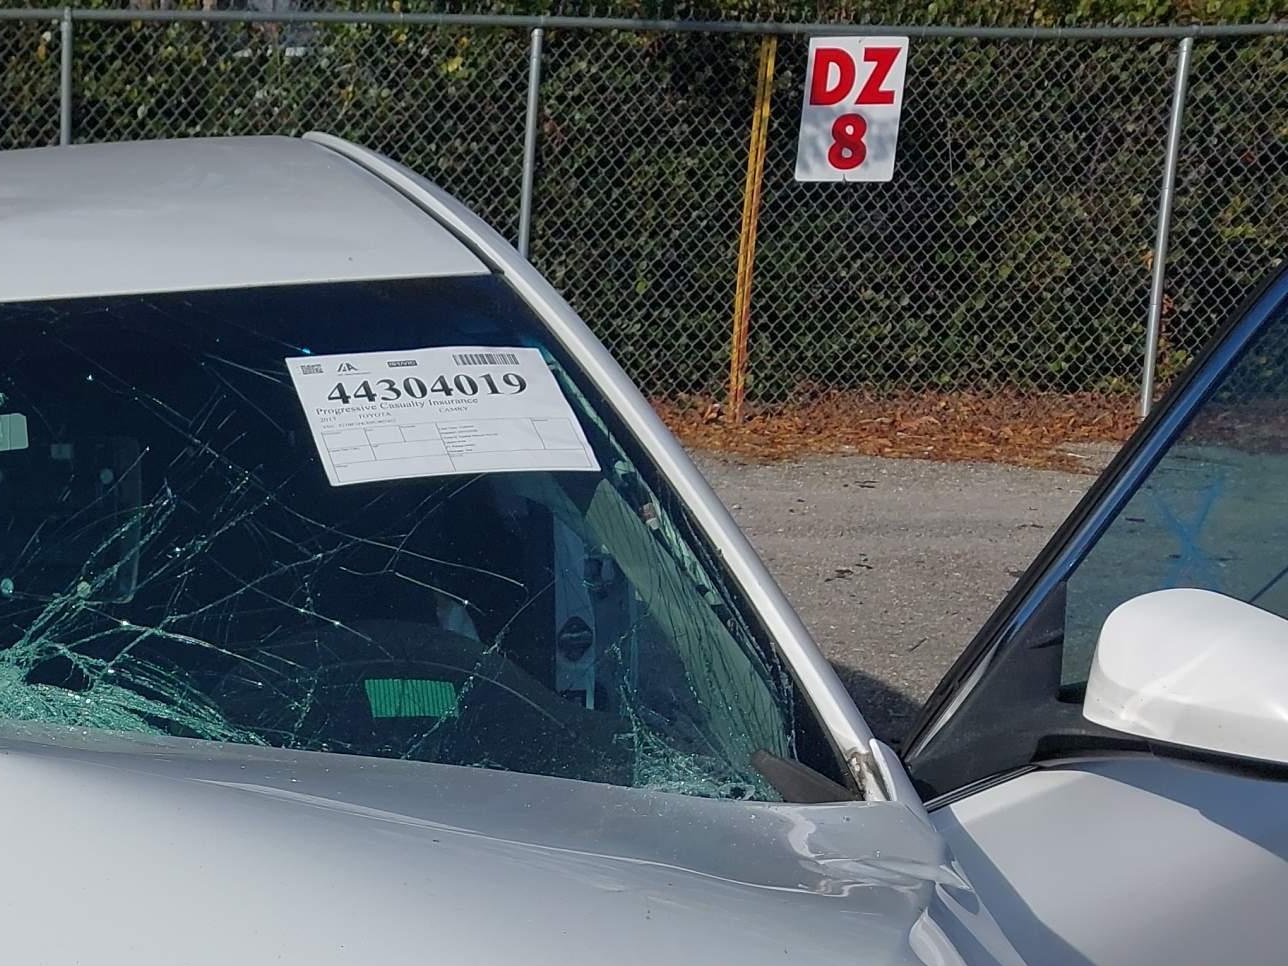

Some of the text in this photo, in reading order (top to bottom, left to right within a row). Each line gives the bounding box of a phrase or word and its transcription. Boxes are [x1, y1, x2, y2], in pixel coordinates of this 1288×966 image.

[809, 47, 902, 106] DZ
[827, 112, 867, 170] 8
[315, 398, 479, 416] Progressive Casualty Insurance
[326, 372, 528, 404] 44304019
